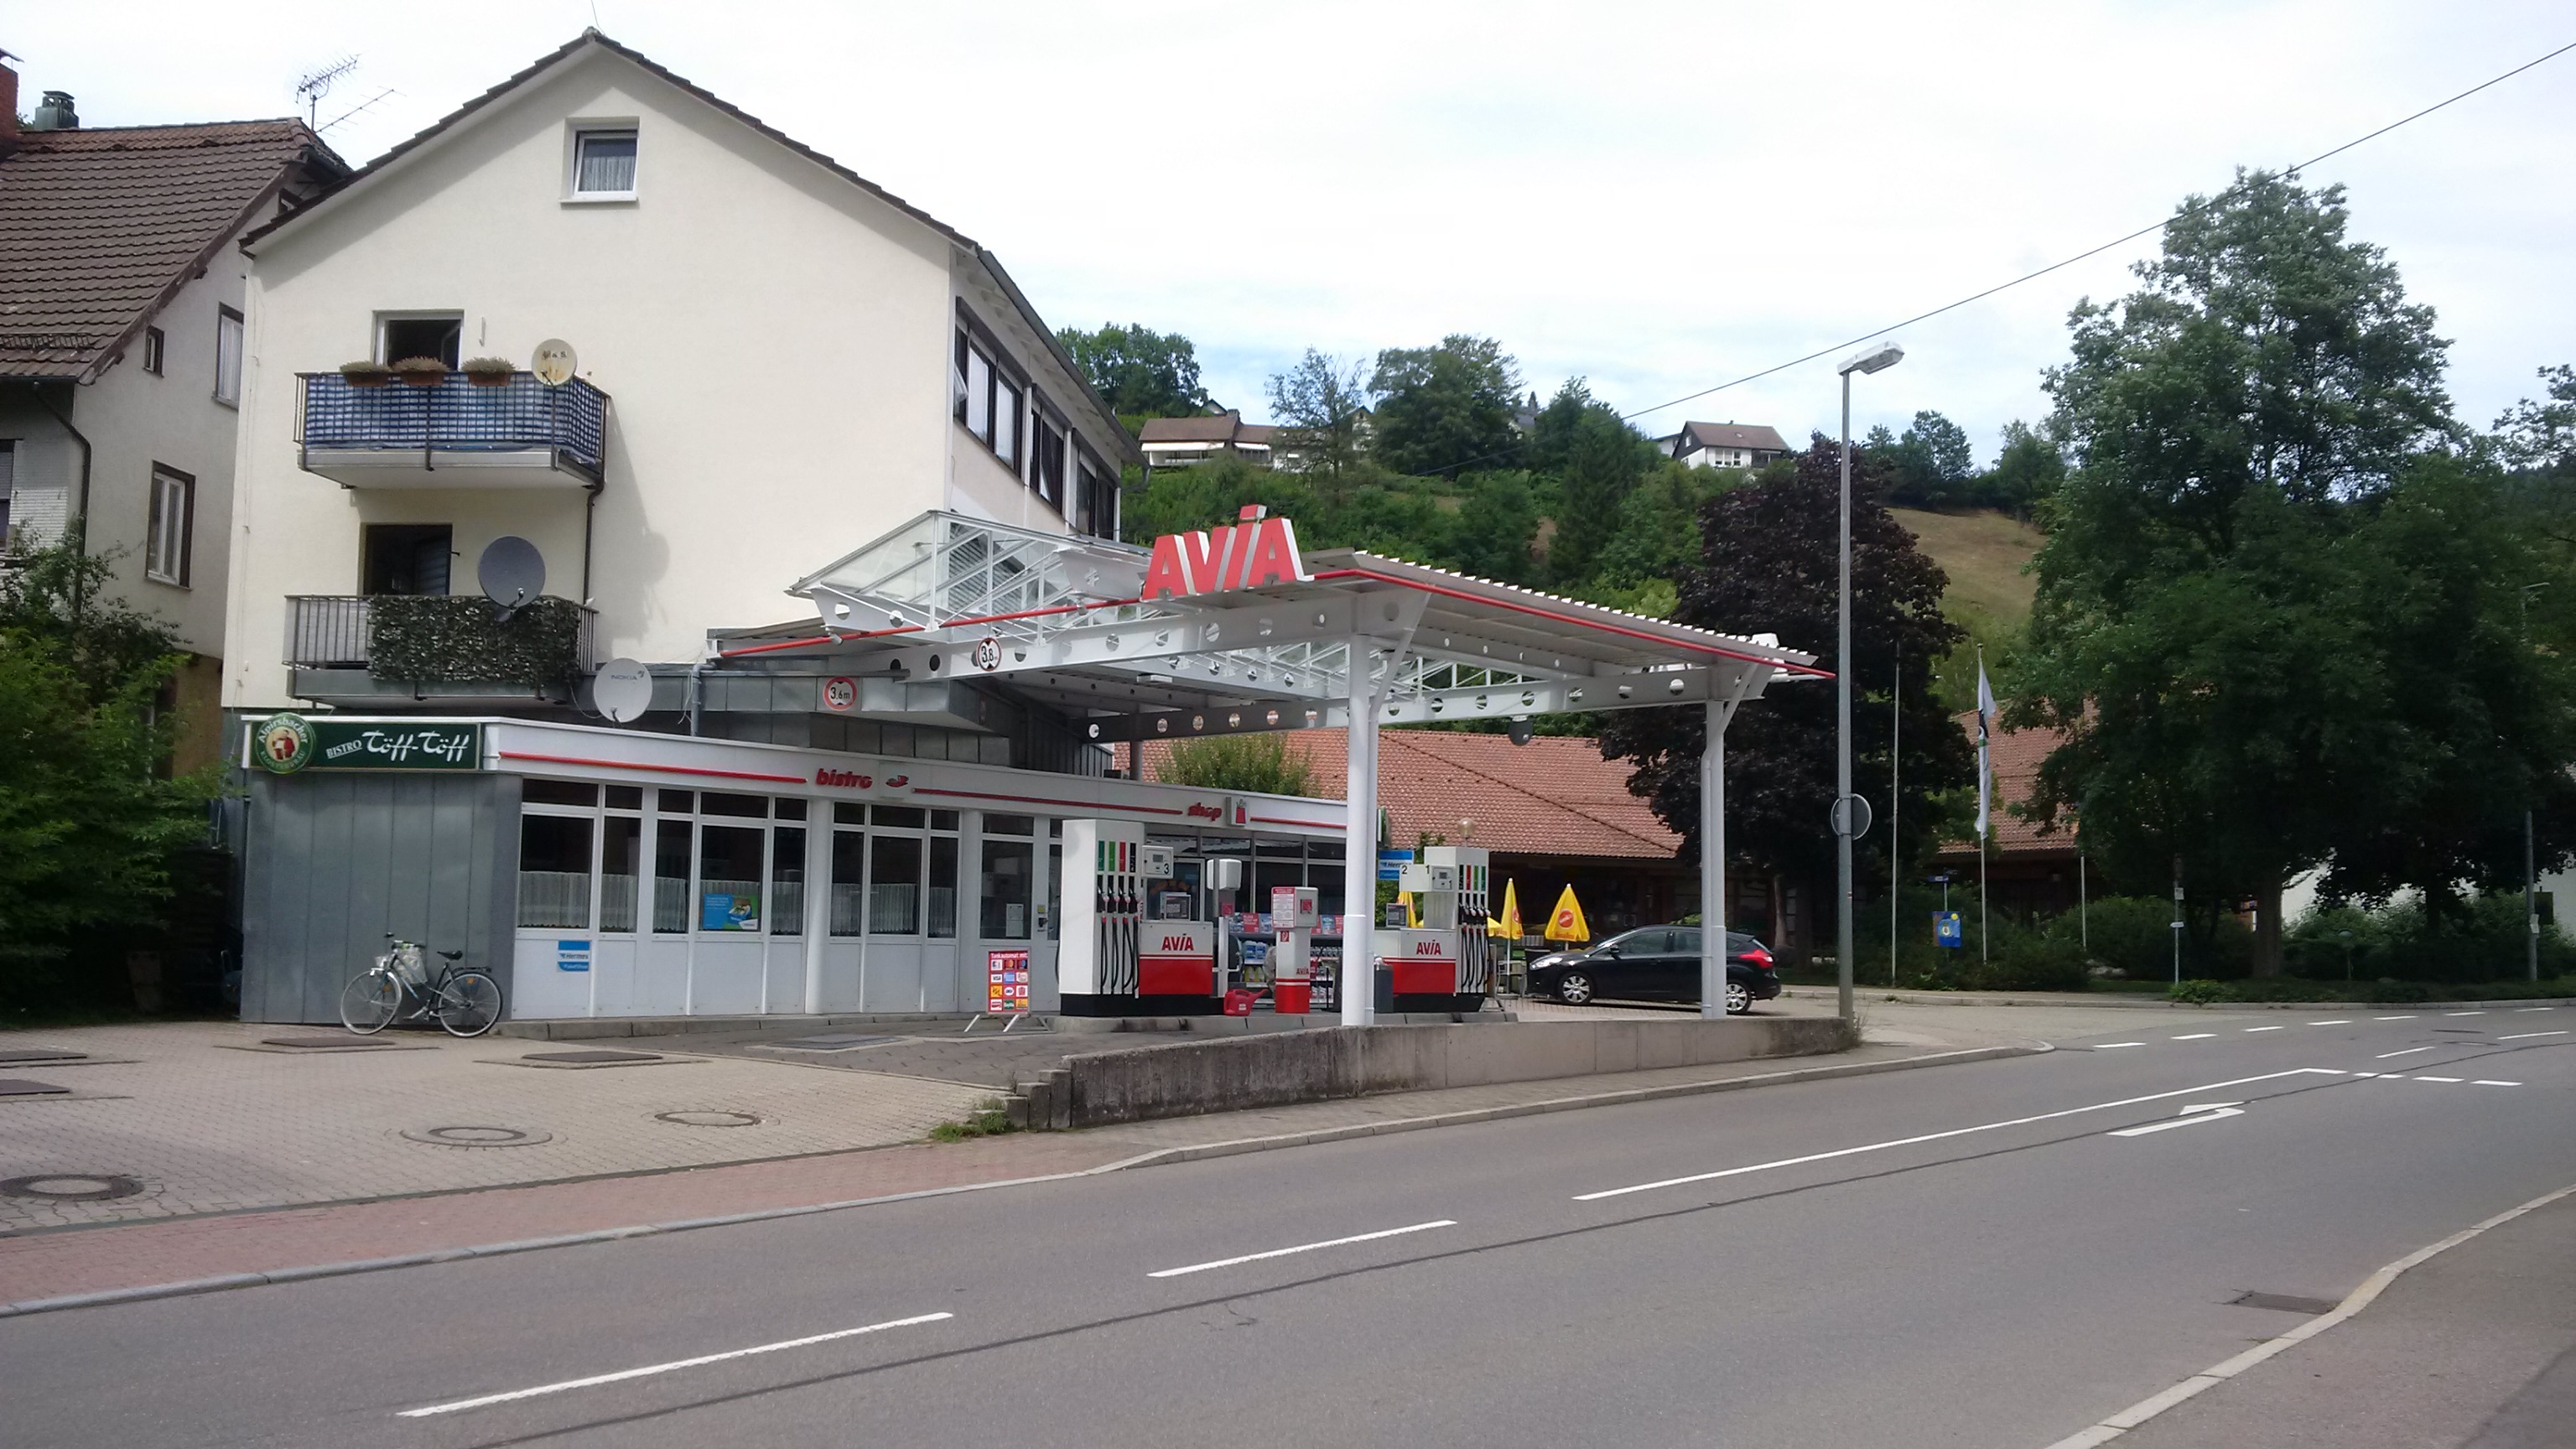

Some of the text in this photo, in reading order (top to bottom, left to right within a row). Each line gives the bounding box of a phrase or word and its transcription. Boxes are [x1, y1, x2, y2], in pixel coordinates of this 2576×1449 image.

[1141, 504, 1305, 601] AVIA
[258, 716, 309, 744] Alpirsbacher
[325, 739, 363, 759] BISTRO
[816, 767, 873, 789] bistro
[1187, 802, 1223, 822] shop
[1164, 863, 1170, 875] 3
[1401, 865, 1408, 875] 2
[1426, 865, 1430, 875] 1
[1161, 932, 1194, 952] AVIA
[1416, 939, 1441, 955] AVIA
[1296, 967, 1310, 975] AVIA
